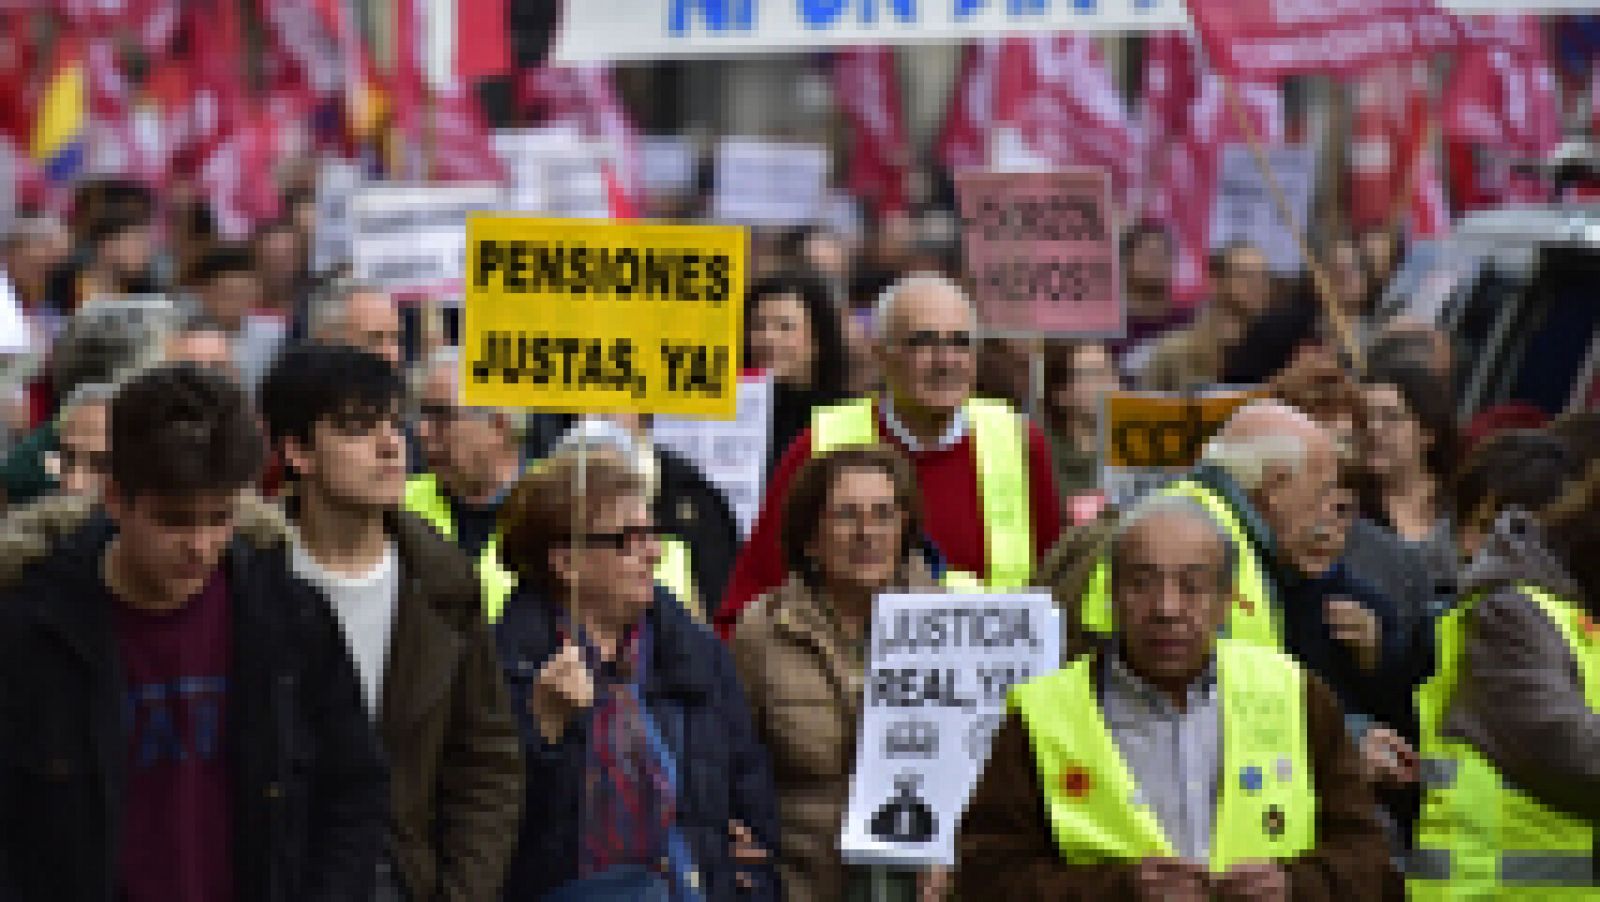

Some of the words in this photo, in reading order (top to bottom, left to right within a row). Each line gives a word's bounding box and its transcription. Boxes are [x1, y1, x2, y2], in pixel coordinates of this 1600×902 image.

[473, 240, 731, 305] PENSIONES
[472, 331, 648, 399] JUSTAS,
[660, 341, 730, 398] YA!
